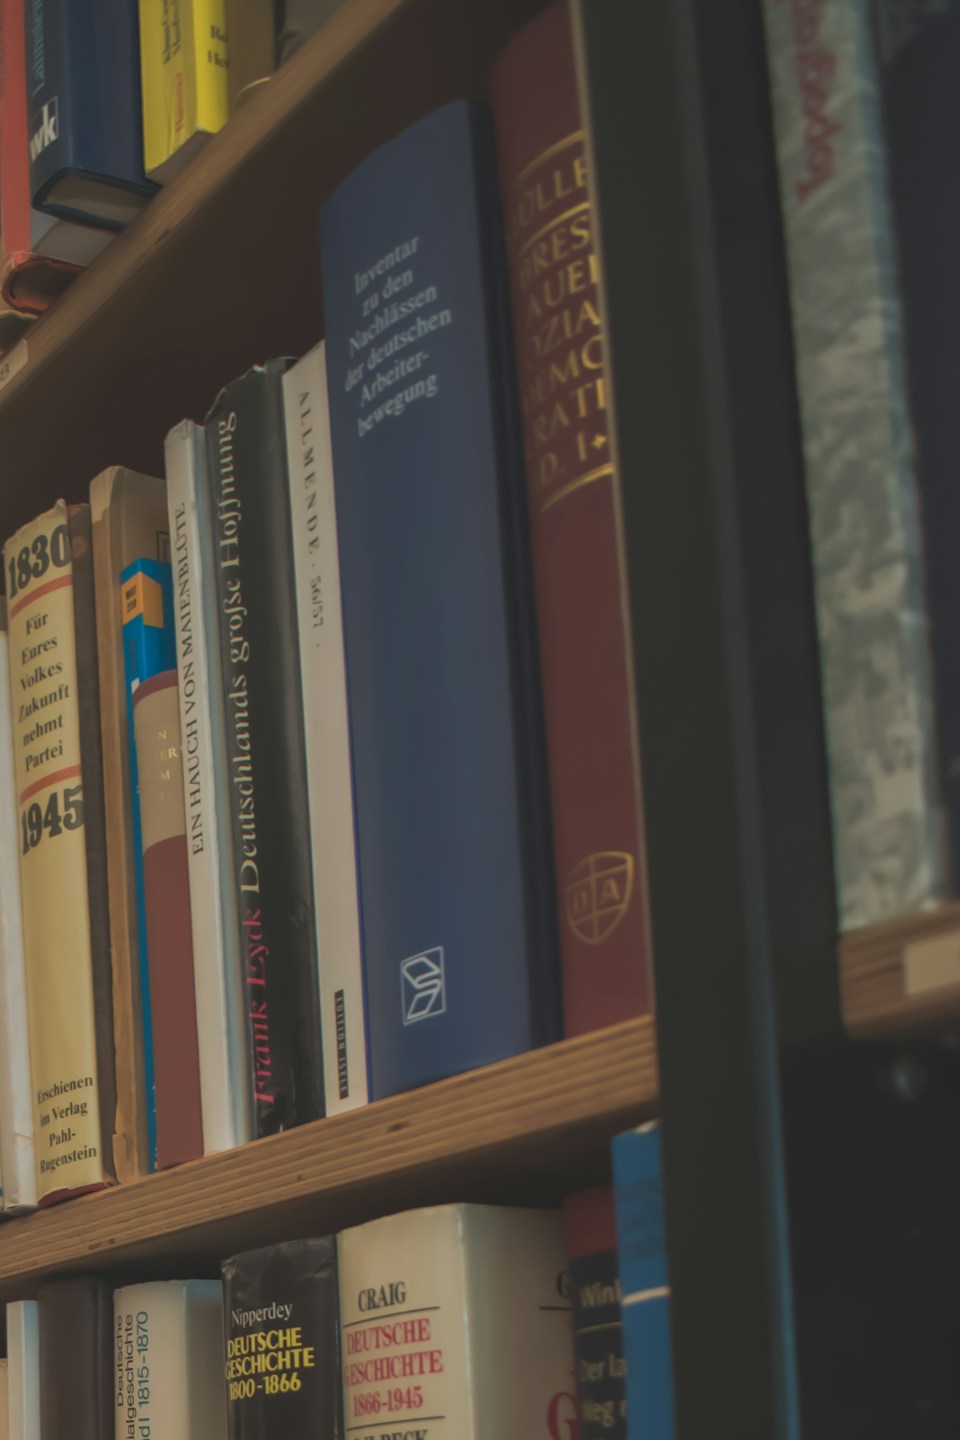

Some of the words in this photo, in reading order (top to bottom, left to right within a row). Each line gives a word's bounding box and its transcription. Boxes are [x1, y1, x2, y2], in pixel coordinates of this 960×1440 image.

[354, 236, 420, 295] Inventar
[362, 293, 379, 318] zu
[382, 269, 414, 300] den
[349, 285, 437, 360] Nachlässen
[345, 363, 365, 392] der
[367, 309, 452, 371] deutschen
[360, 351, 430, 409] Arbeiter-
[357, 373, 438, 438] bewegung
[217, 411, 241, 568] Hoffnung
[299, 390, 321, 555] ALLMENDE
[8, 524, 72, 599] 1830
[175, 502, 193, 655] MAIENBLÜTE
[25, 613, 49, 636] Für
[21, 638, 58, 666] Eures
[20, 662, 63, 692] Volkes
[182, 661, 197, 711] VON
[18, 686, 70, 723] Zukunft
[23, 713, 64, 747] nehmt
[25, 740, 64, 773] Partei
[186, 719, 201, 809] HAUCH
[229, 674, 260, 894] Deutschlands
[21, 784, 86, 855] 1945
[192, 816, 205, 856] EIN
[243, 908, 270, 988] Eyck
[249, 1002, 274, 1103] Frank
[37, 1076, 94, 1105] Erschienen
[40, 1114, 51, 1127] im
[52, 1101, 88, 1121] Verlag
[40, 1145, 97, 1174] Rugenstein
[49, 1127, 77, 1147] Pahl-
[231, 1301, 294, 1328] Nipperdey
[357, 1281, 407, 1313] CRAIG
[115, 1314, 123, 1407] Deutsche
[136, 1311, 150, 1408] 1815-1870
[228, 1327, 302, 1359] DEUTSCHE
[346, 1317, 432, 1356] DEUTSCHE
[225, 1347, 315, 1381] GESCHICHTE
[353, 1385, 424, 1418] 1866-1945
